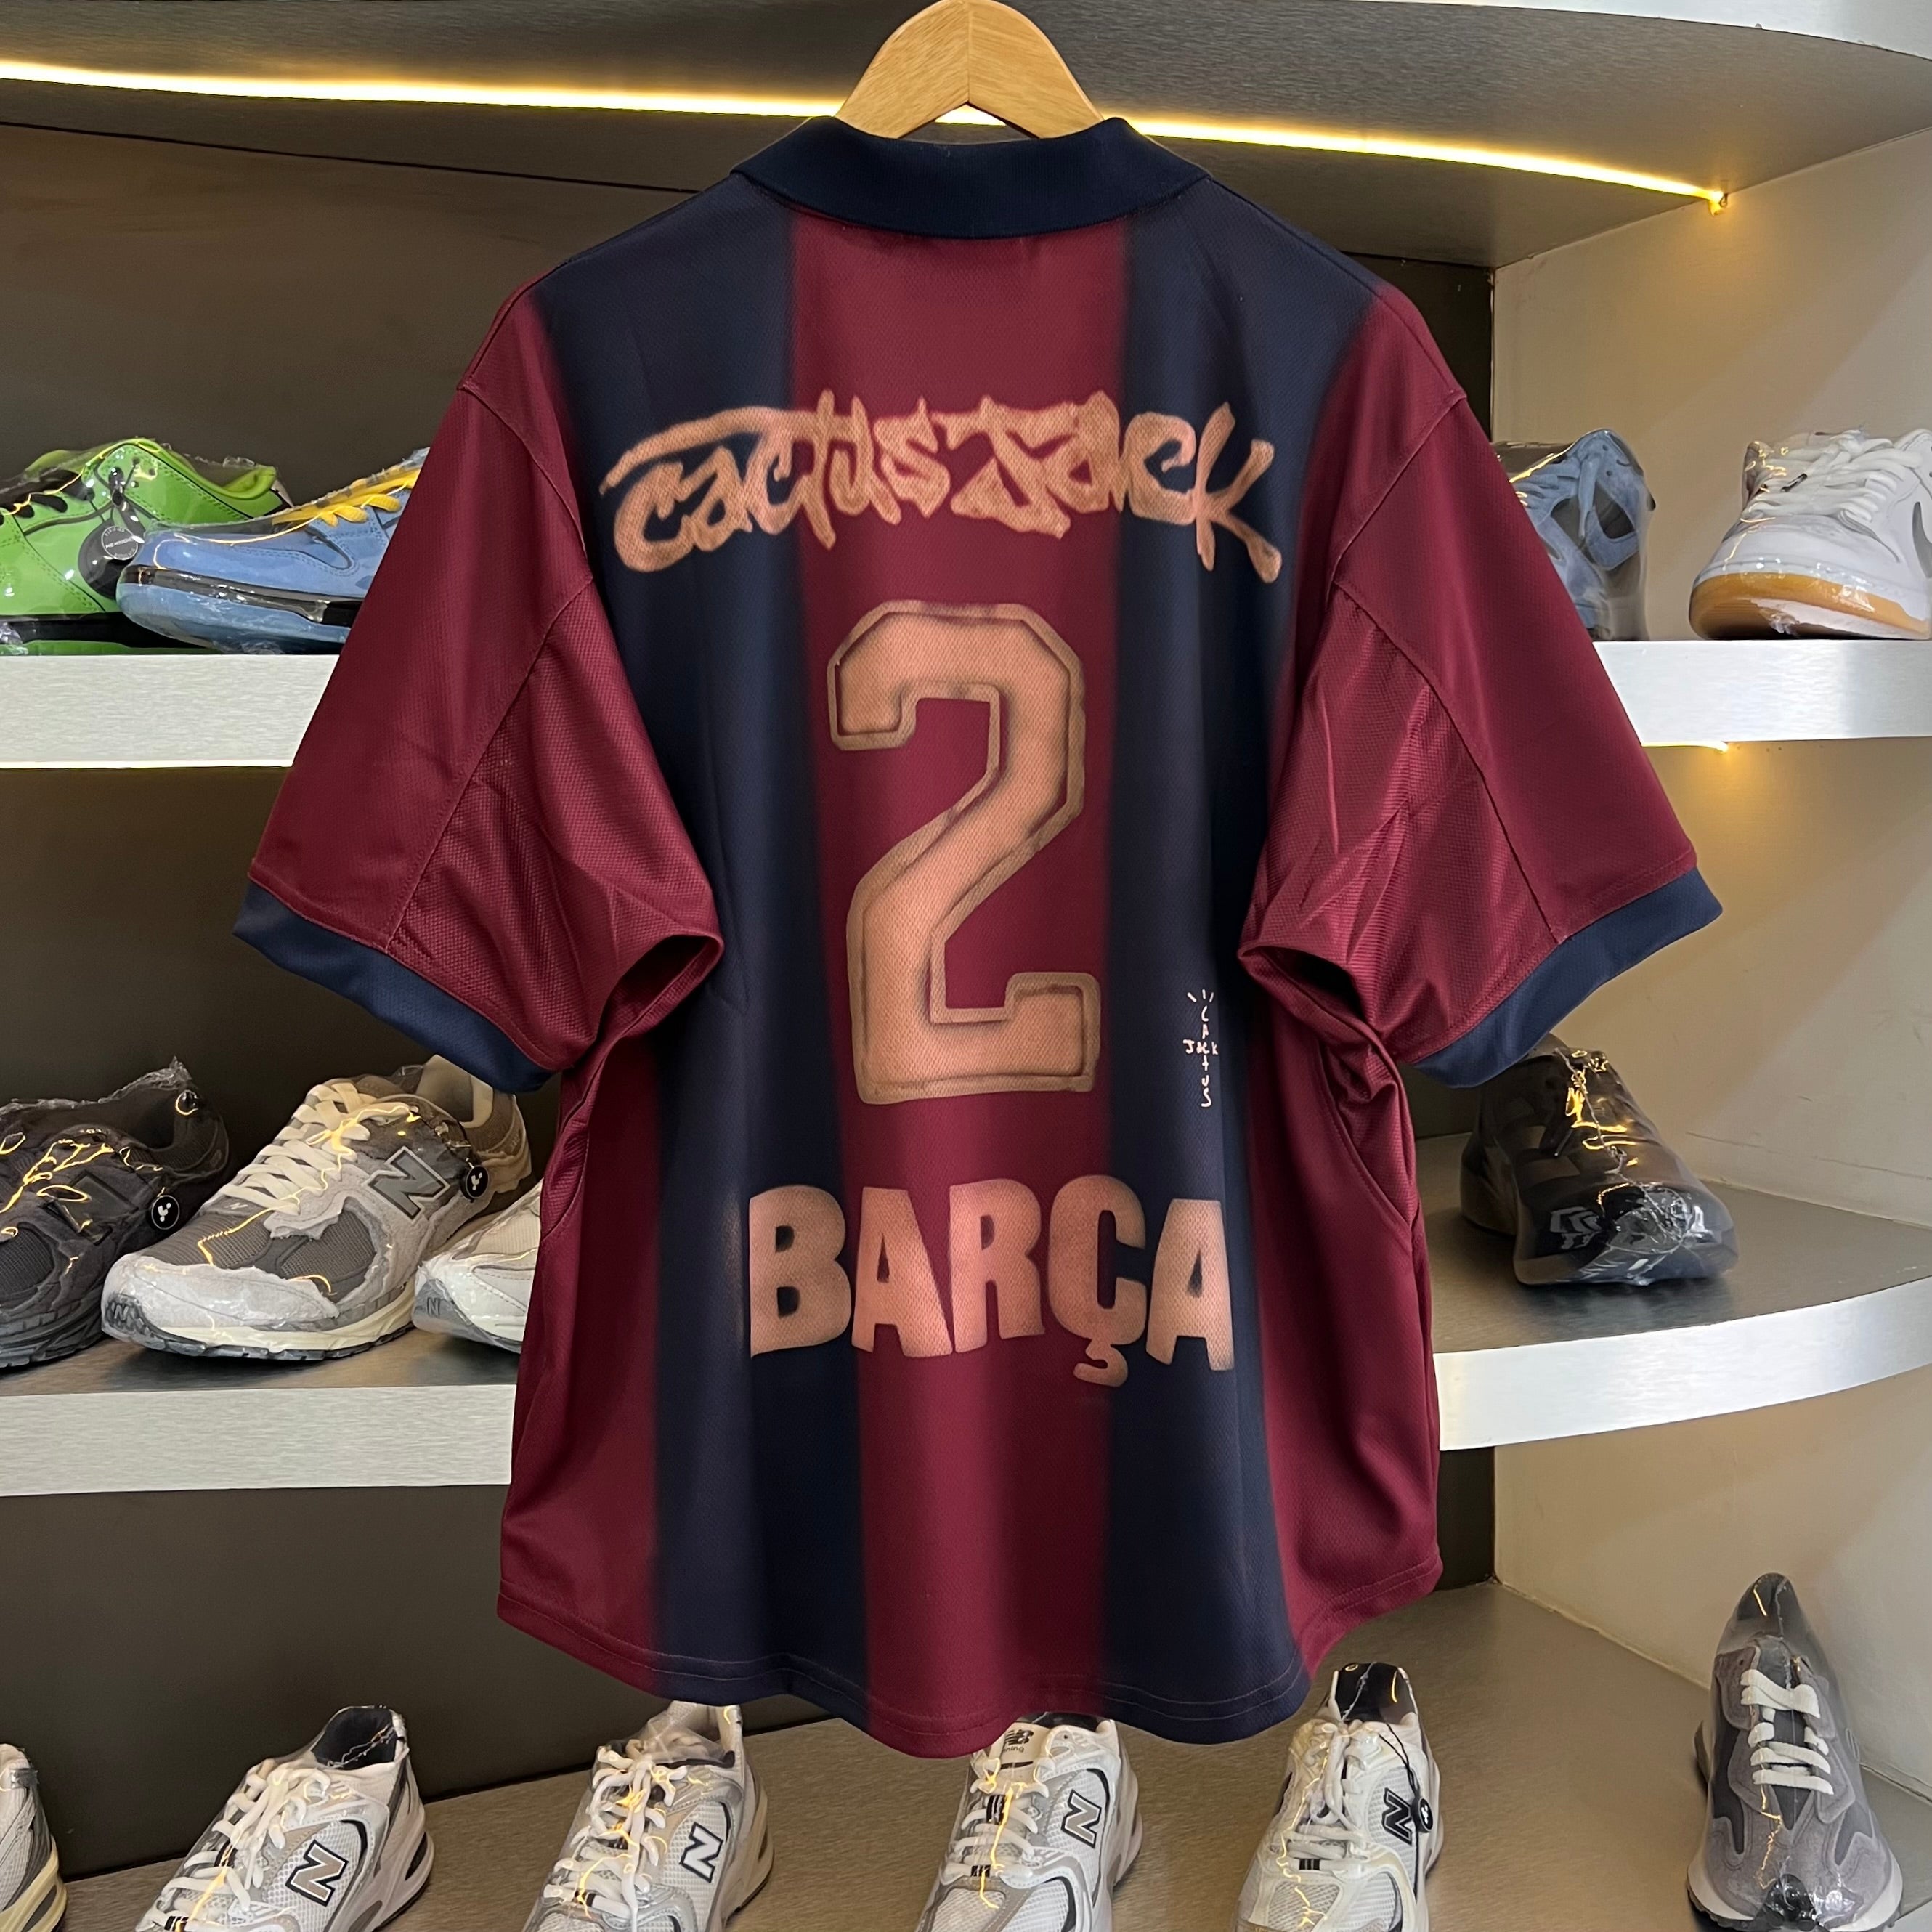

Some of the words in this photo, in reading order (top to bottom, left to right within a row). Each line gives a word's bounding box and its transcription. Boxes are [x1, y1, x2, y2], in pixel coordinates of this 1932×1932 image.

[827, 599, 1101, 1105] 2
[749, 1174, 1235, 1388] BARÇA
[679, 1821, 723, 1883] N
[1060, 1789, 1102, 1849] N
[285, 1838, 349, 1907] N
